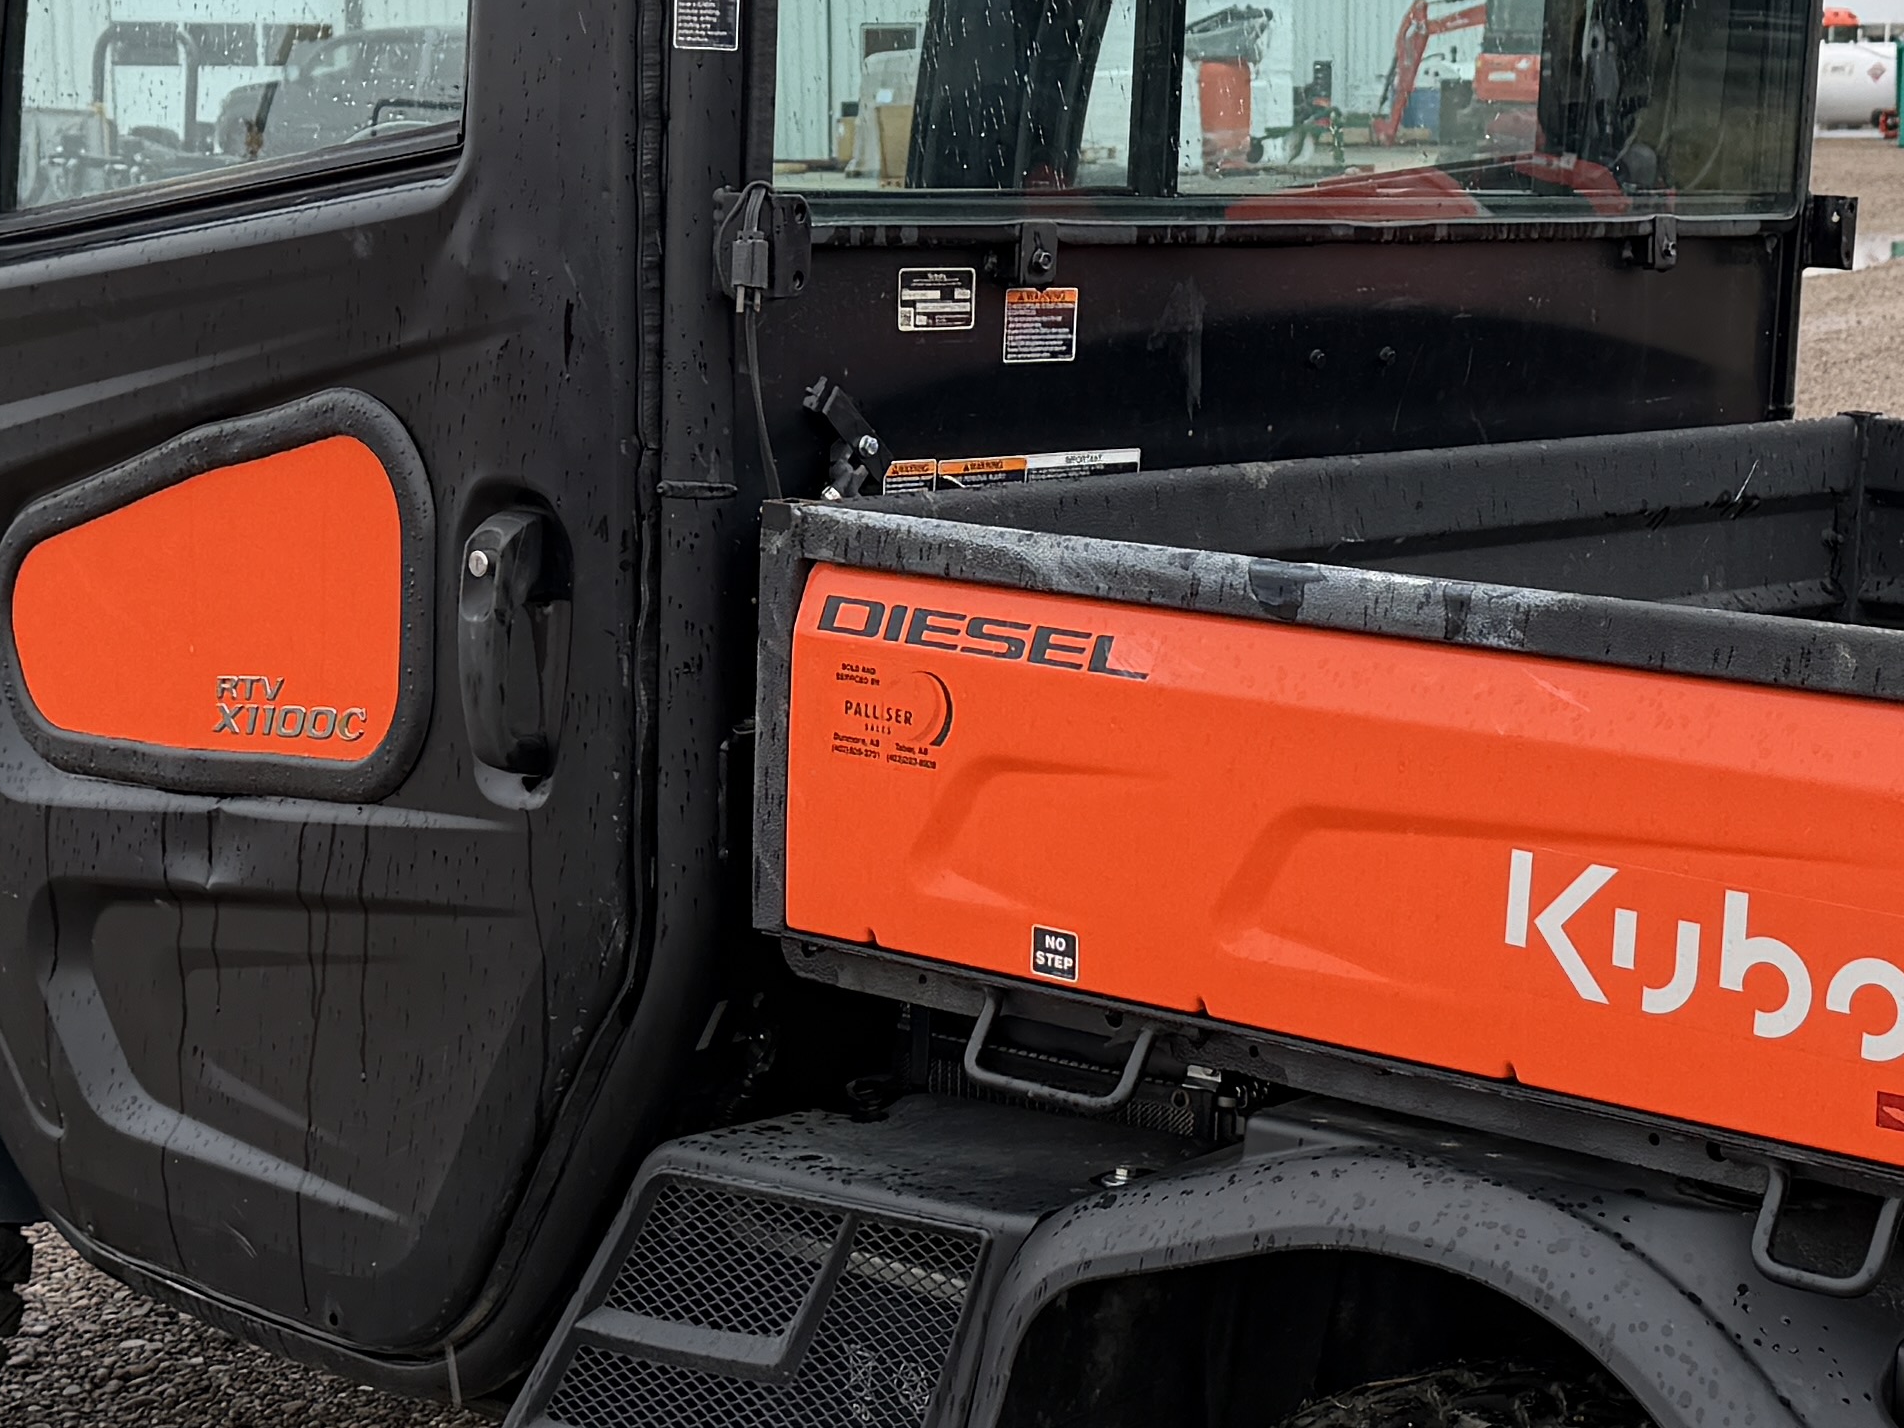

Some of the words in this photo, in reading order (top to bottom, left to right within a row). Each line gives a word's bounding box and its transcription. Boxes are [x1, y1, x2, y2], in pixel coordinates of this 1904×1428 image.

[817, 595, 1149, 680] DIESEL
[216, 675, 285, 701] RTV
[213, 703, 368, 741] X1100C
[845, 700, 913, 725] PALLISER
[1045, 934, 1067, 951] NO
[1035, 950, 1074, 970] STEP
